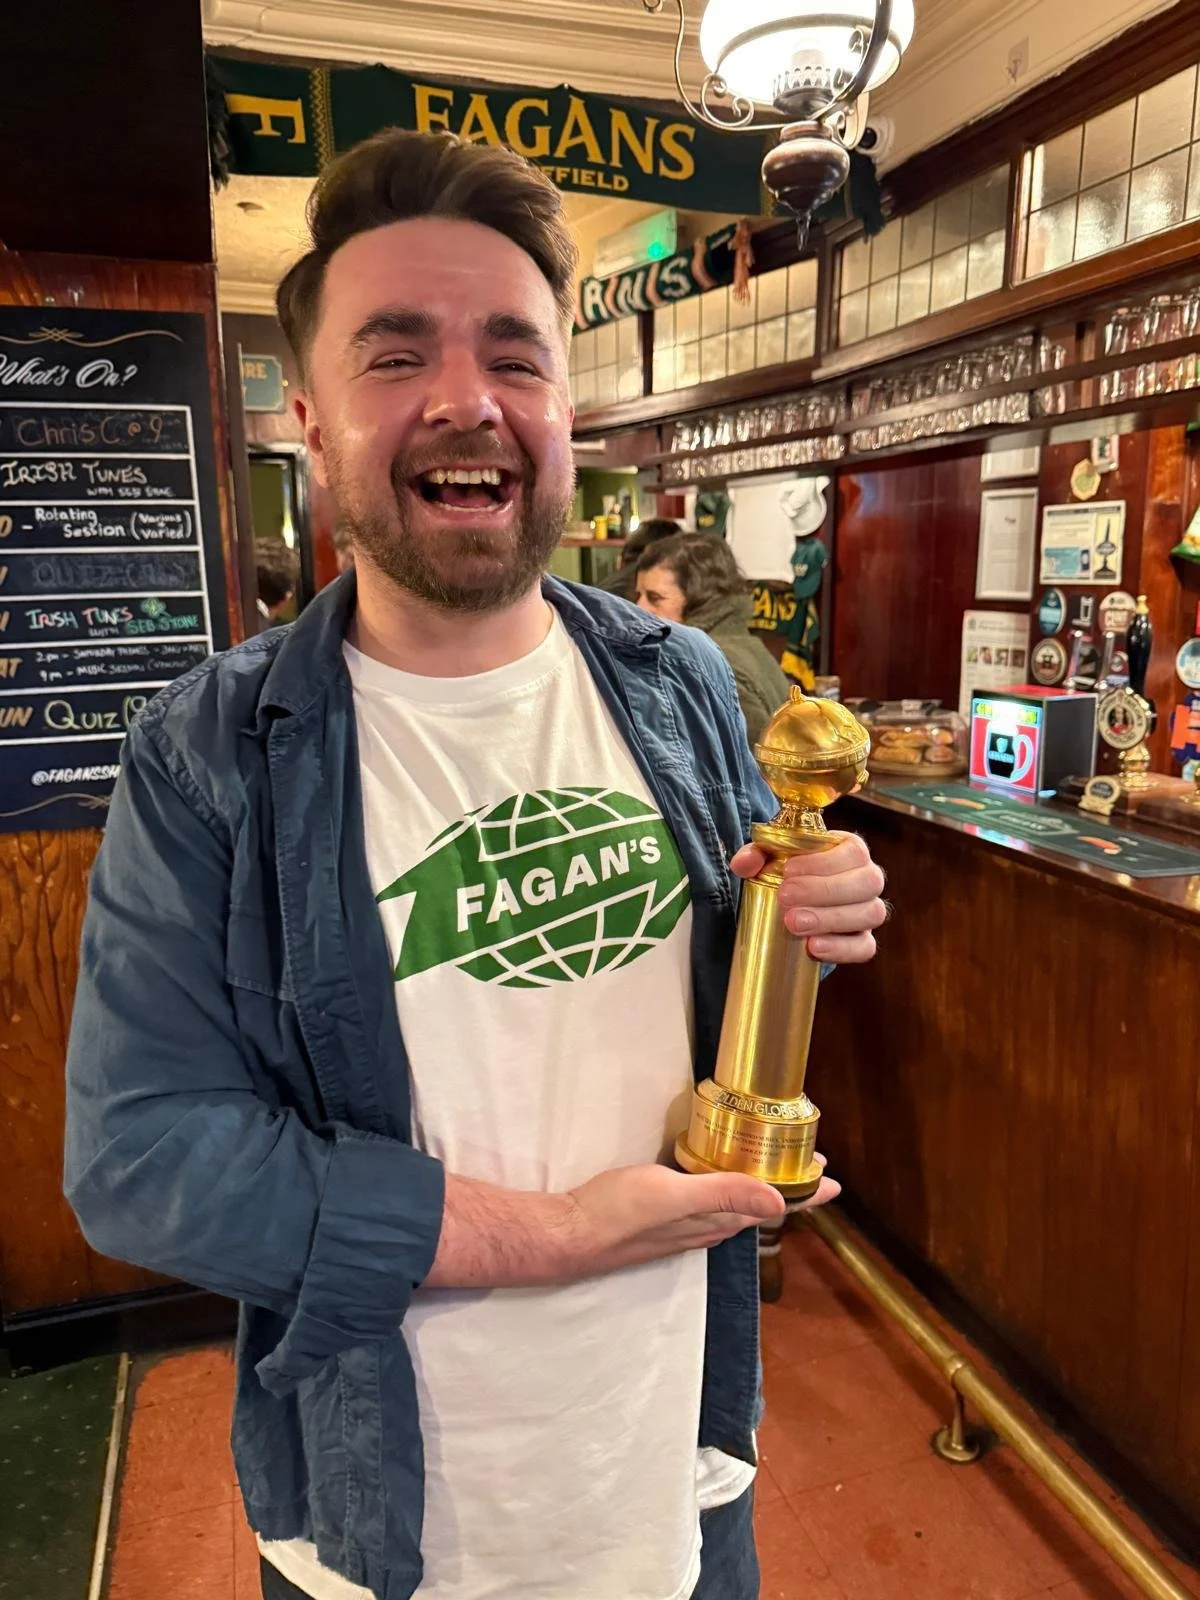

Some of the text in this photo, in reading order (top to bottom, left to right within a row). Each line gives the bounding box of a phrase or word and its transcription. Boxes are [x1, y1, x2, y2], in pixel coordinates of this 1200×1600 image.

[412, 83, 696, 181] FAGANS
[0, 354, 138, 389] What's On?
[17, 418, 96, 447] Chris
[82, 462, 148, 484] TUNES
[35, 507, 98, 528] Rotating
[63, 522, 126, 538] Session
[456, 835, 662, 933] FAGAN'S
